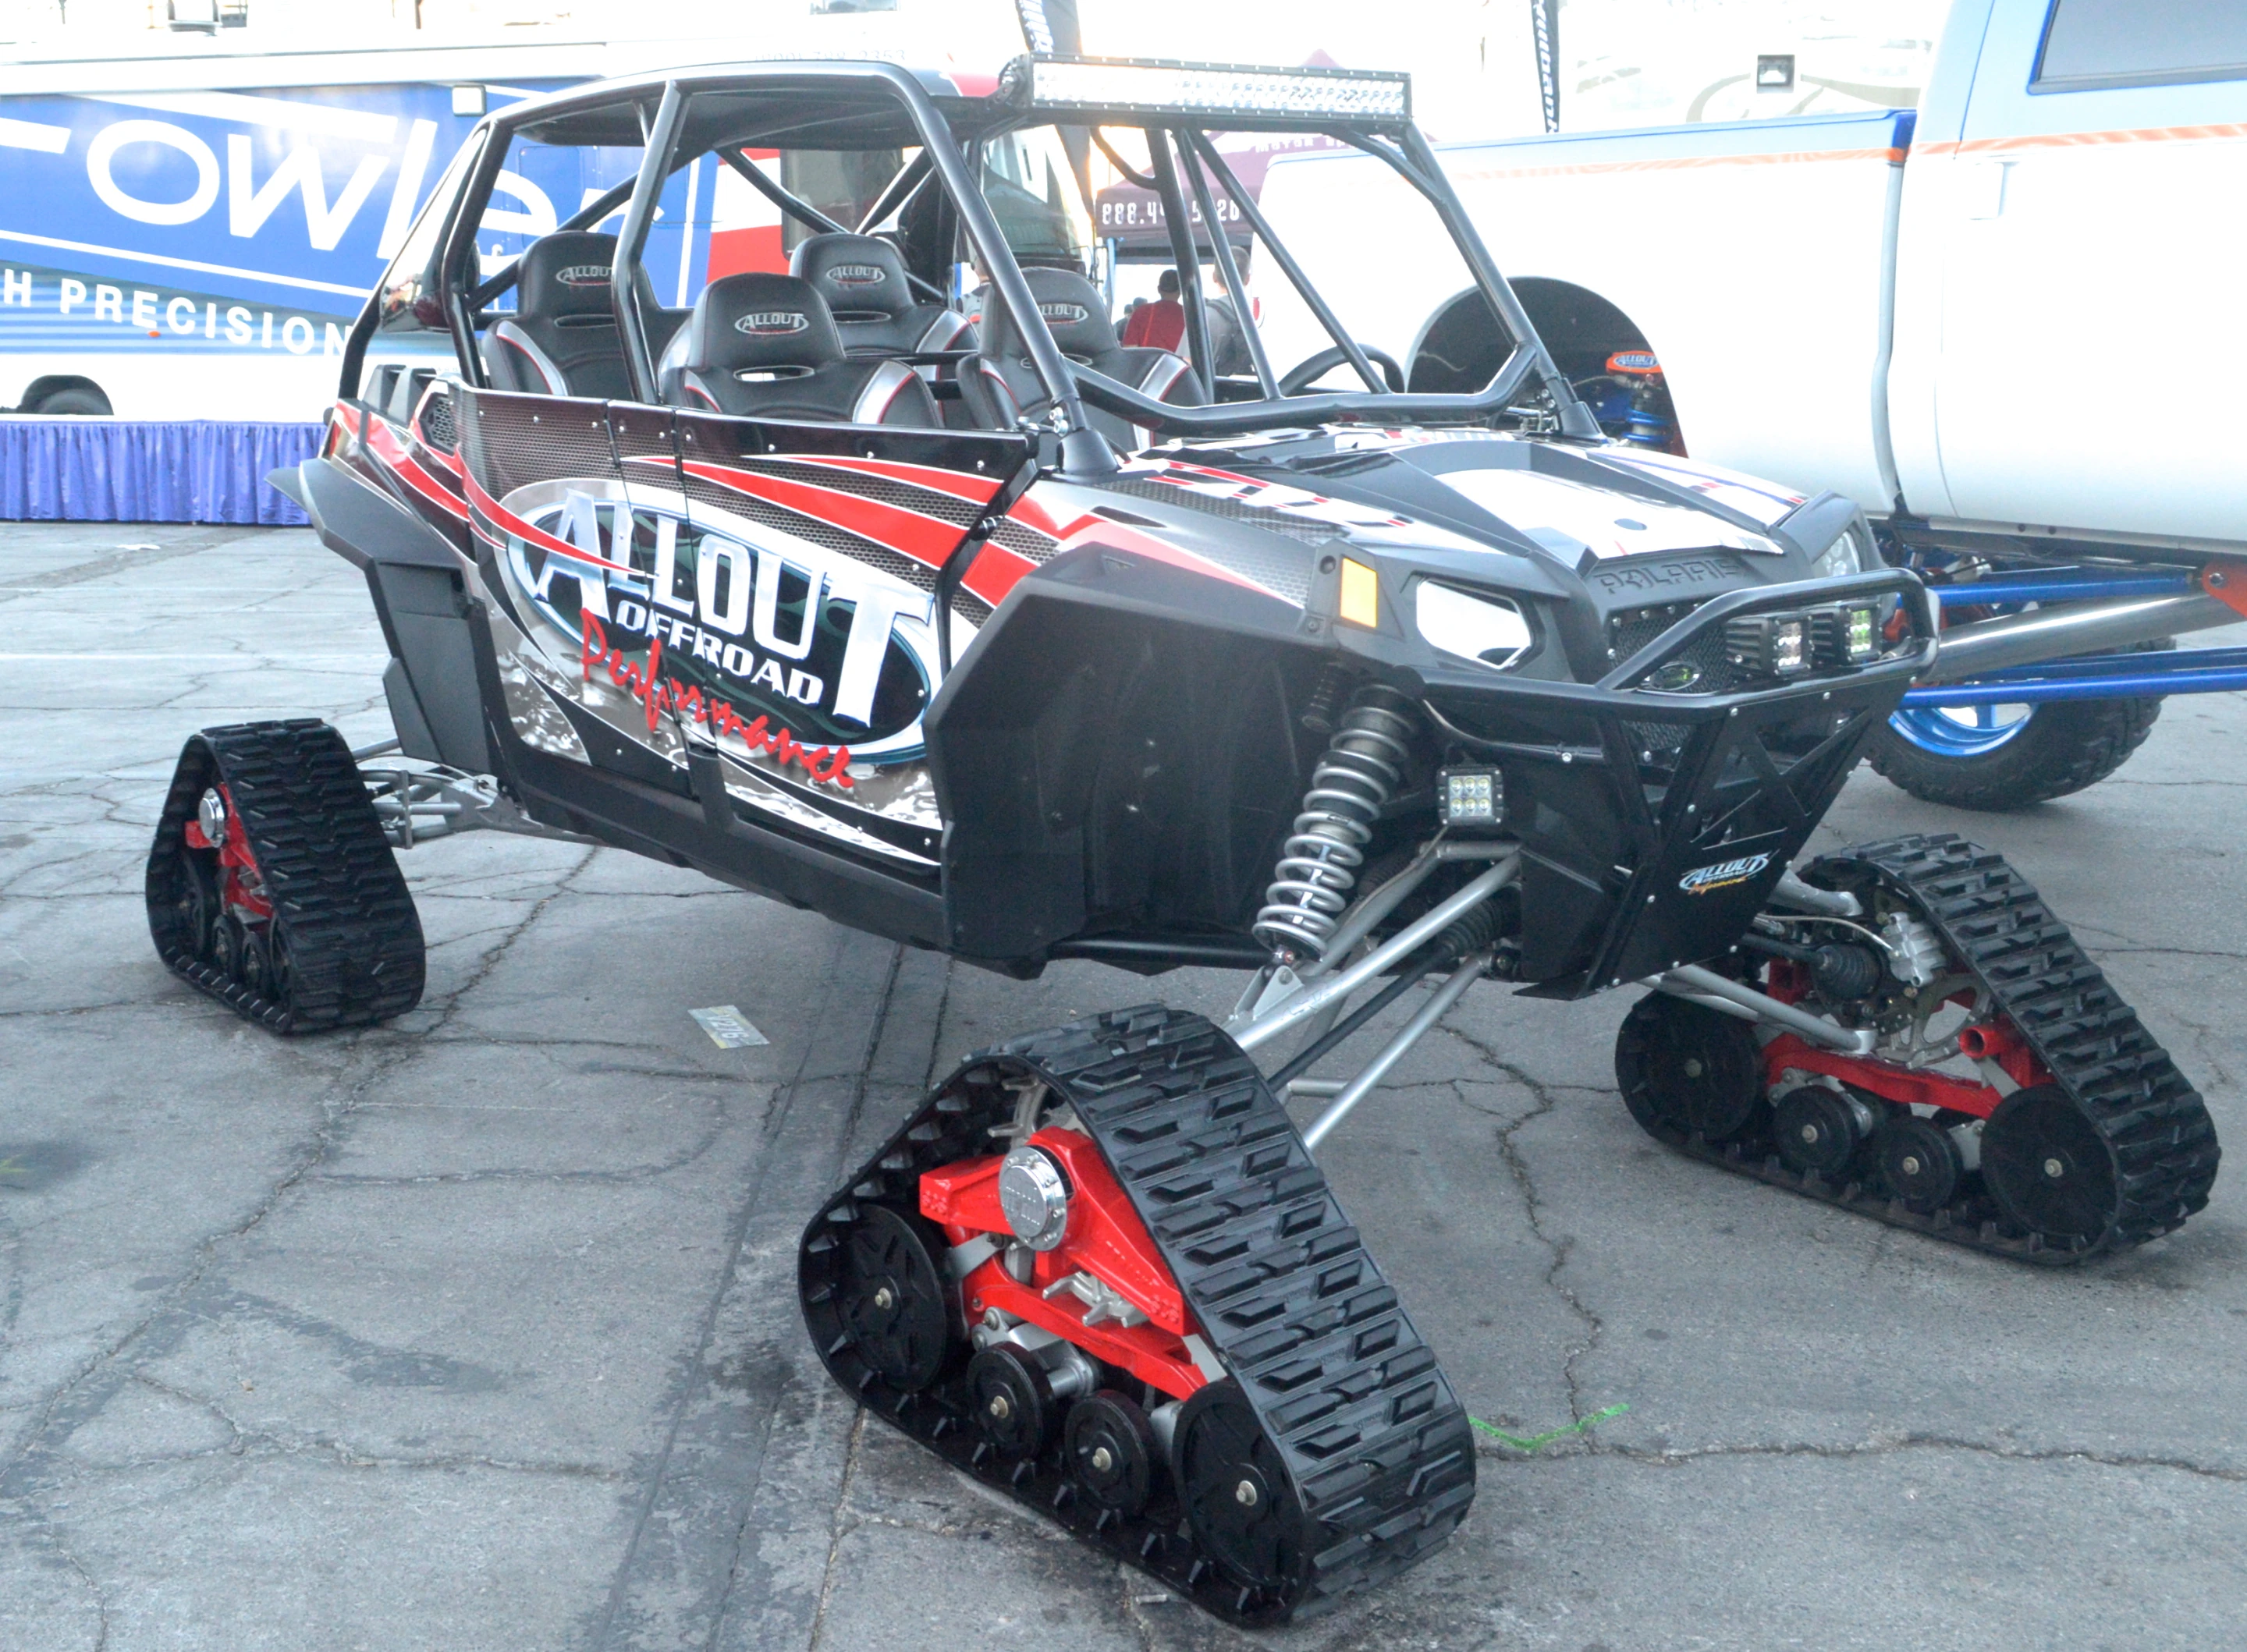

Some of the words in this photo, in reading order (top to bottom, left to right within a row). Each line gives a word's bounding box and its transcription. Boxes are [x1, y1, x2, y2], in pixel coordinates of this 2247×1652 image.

[563, 266, 612, 281] ALLOU
[59, 278, 353, 356] PRECISION
[742, 313, 804, 330] ALLOUT
[1040, 303, 1083, 319] LLOUT
[1594, 557, 1741, 594] POLARIS
[534, 488, 935, 729] ALLOUT
[616, 600, 825, 705] OFFROAD
[579, 607, 854, 789] Performance
